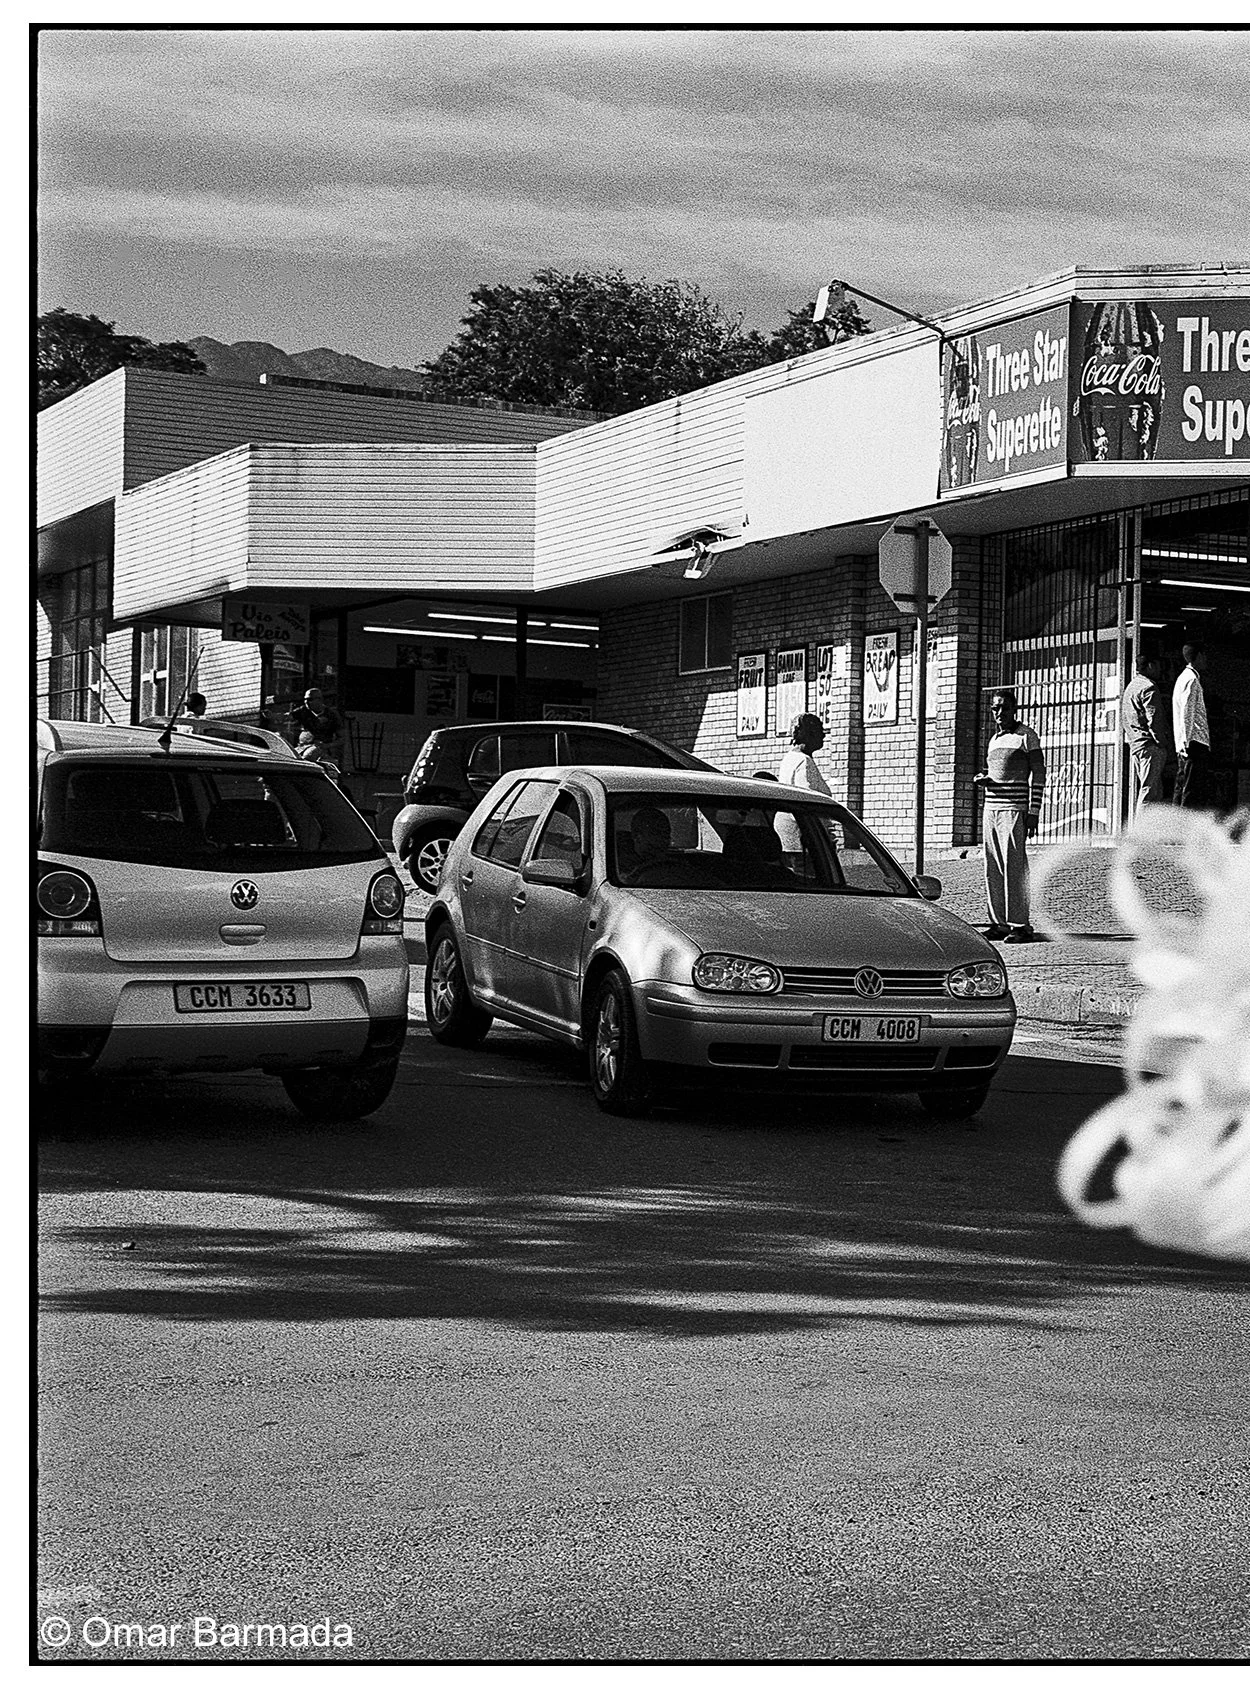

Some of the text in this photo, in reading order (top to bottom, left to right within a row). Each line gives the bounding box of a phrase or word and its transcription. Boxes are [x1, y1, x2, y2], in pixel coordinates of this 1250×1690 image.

[986, 329, 1067, 398] Three Star
[1081, 354, 1161, 396] Coca-Cola
[986, 396, 1061, 473] Superette
[866, 649, 896, 673] BREAD
[739, 667, 764, 689] FRUIT
[190, 985, 297, 1008] CCM 3633
[829, 1018, 916, 1040] CCM 4008
